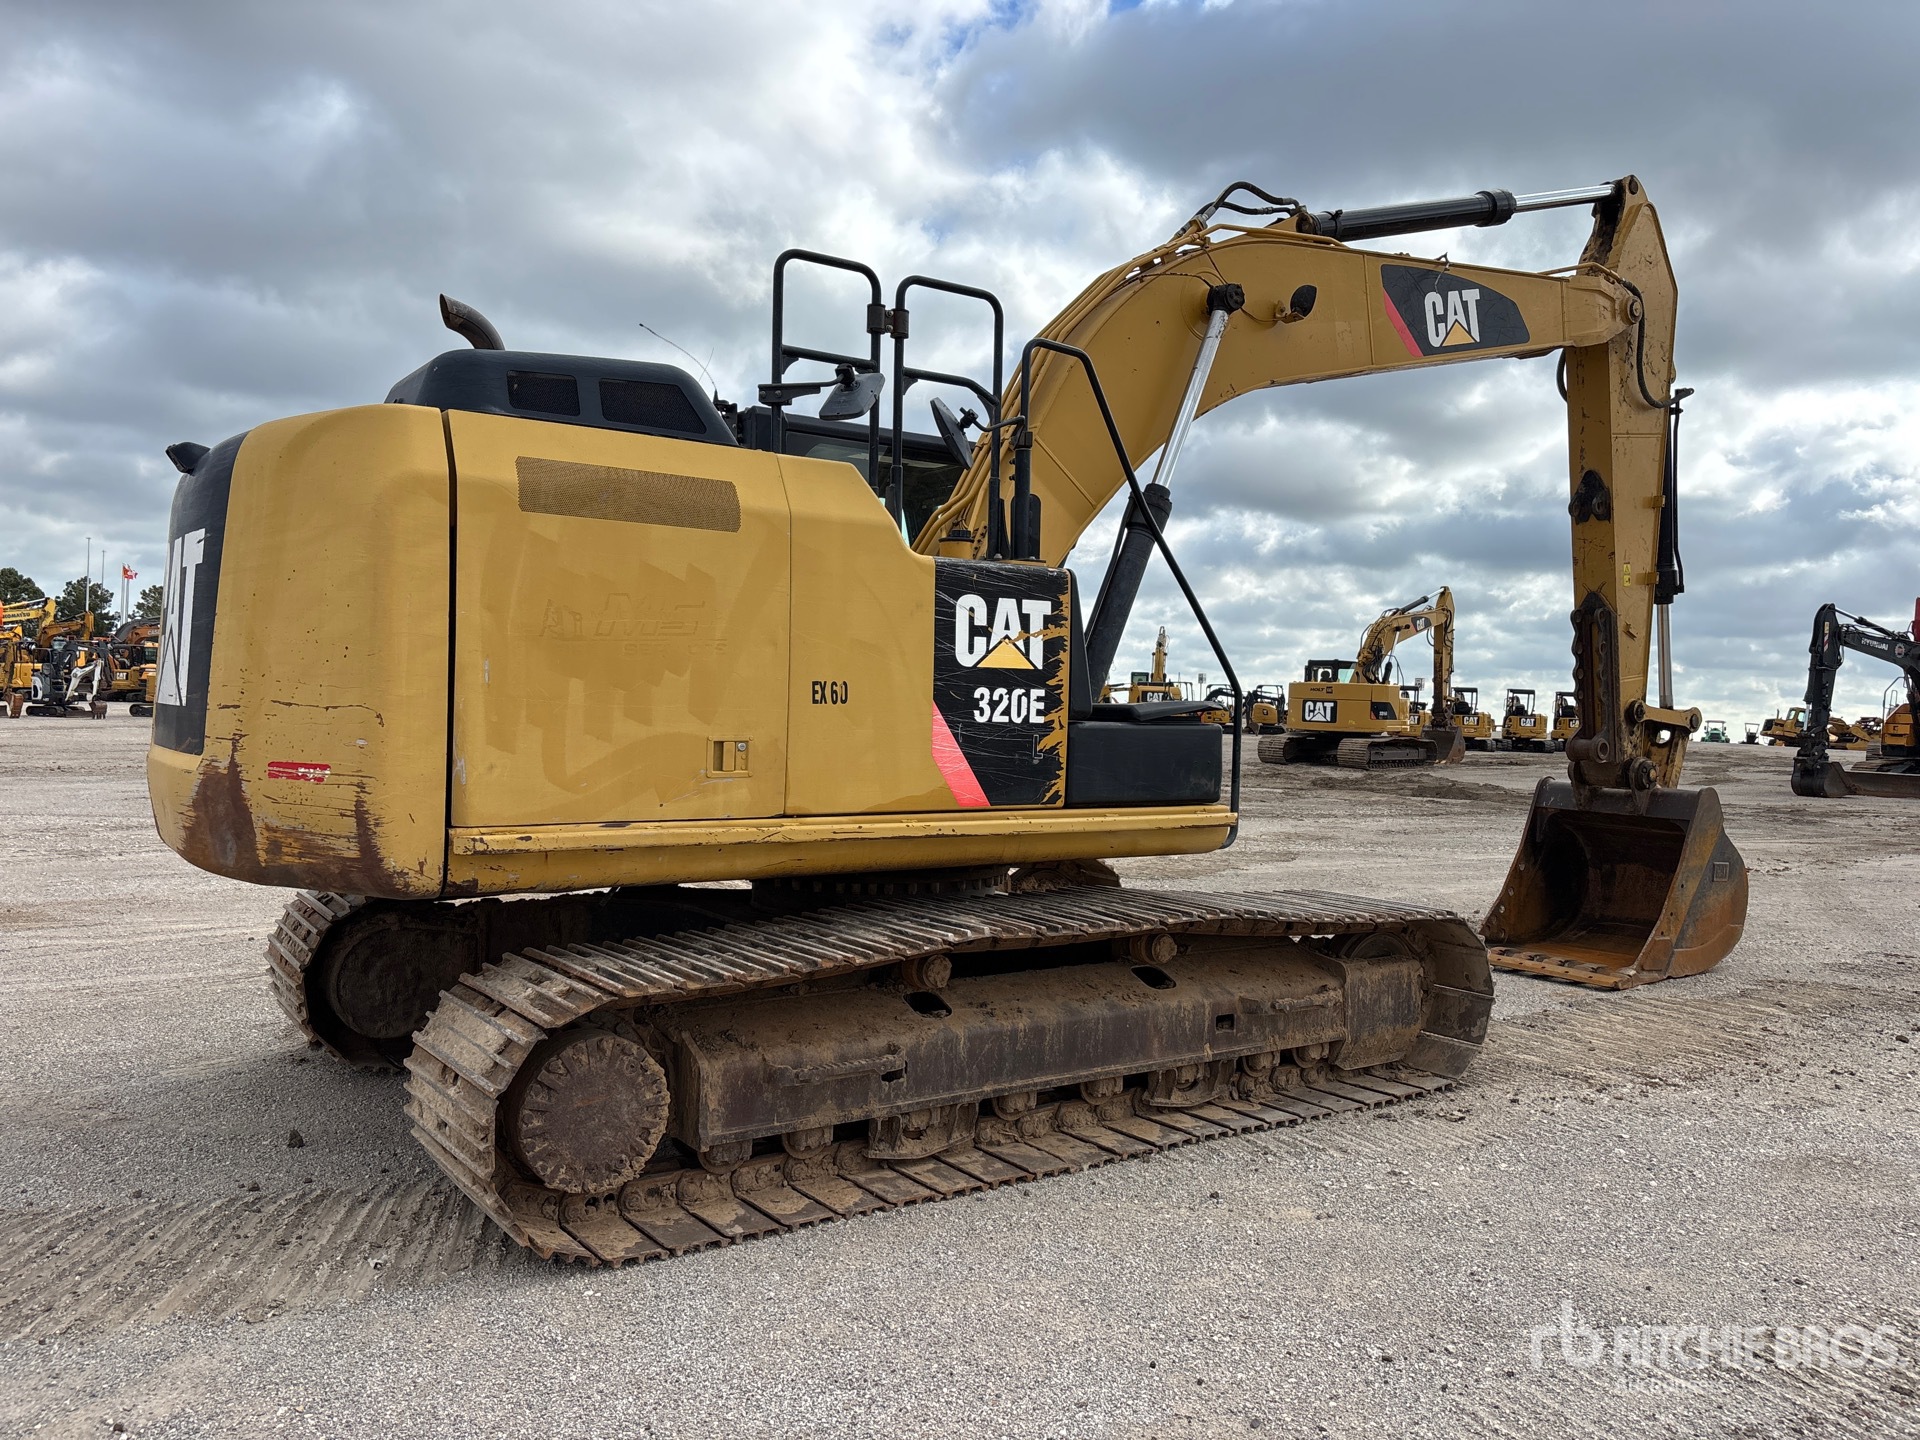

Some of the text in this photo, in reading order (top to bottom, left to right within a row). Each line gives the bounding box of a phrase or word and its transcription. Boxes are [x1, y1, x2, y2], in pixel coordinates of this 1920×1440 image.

[1425, 288, 1480, 347] CAT
[954, 594, 1052, 670] CAT
[811, 680, 849, 705] EX 60
[1146, 692, 1164, 702] CAT
[973, 686, 1046, 724] 320E
[1305, 701, 1335, 722] CAT
[1409, 715, 1419, 724] AT
[1463, 716, 1479, 726] CAT
[1520, 718, 1536, 727] CAT
[1570, 719, 1580, 728] CA
